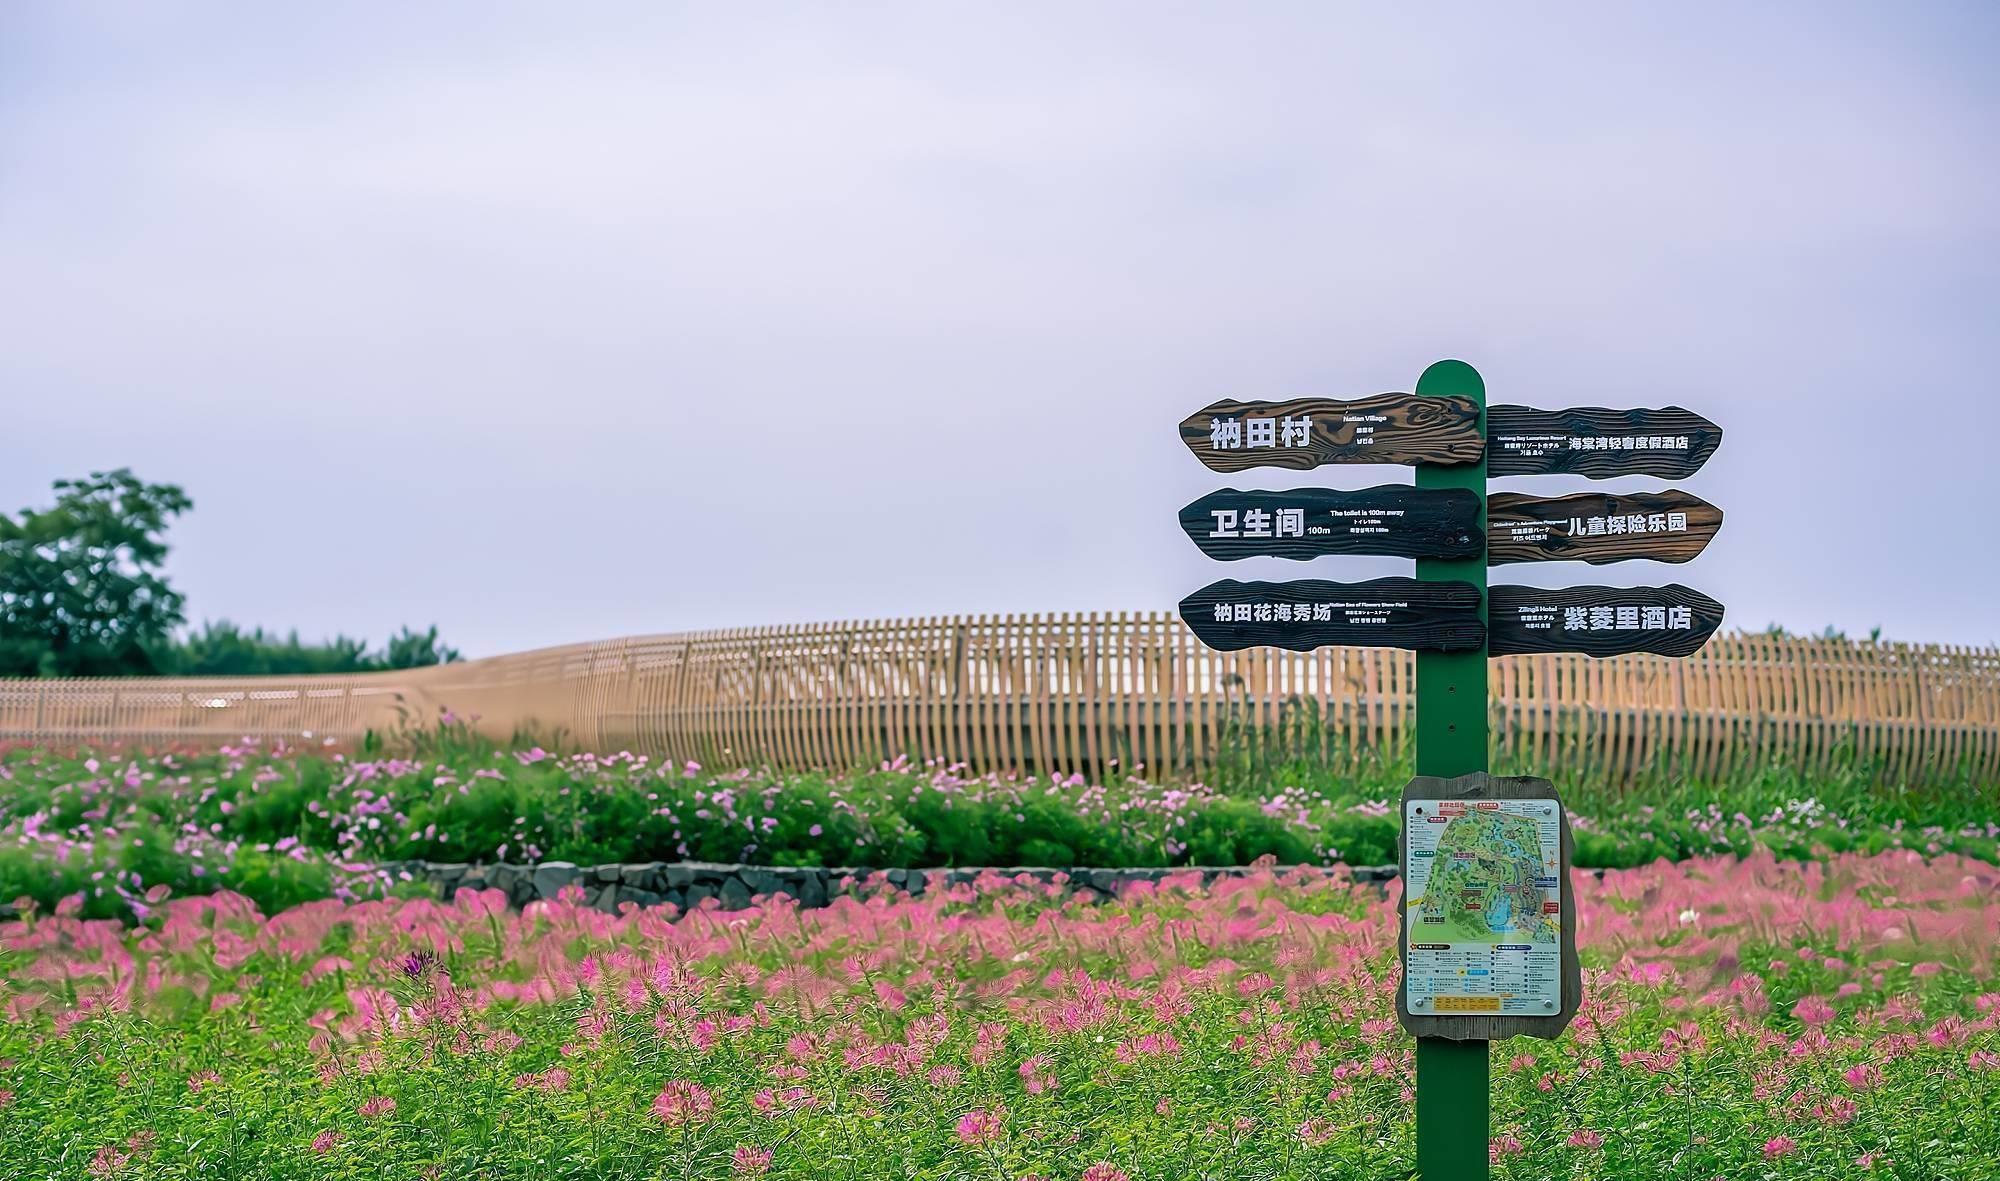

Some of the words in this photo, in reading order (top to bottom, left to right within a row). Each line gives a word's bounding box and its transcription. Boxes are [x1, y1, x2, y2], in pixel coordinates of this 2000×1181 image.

[1568, 436, 1689, 450] 海棠湾轻奢度假酒店
[1209, 508, 1305, 538] 卫生间
[1307, 527, 1331, 535] 100m
[1568, 512, 1687, 537] 儿童探险乐园
[1564, 606, 1692, 631] 紫菱里酒店
